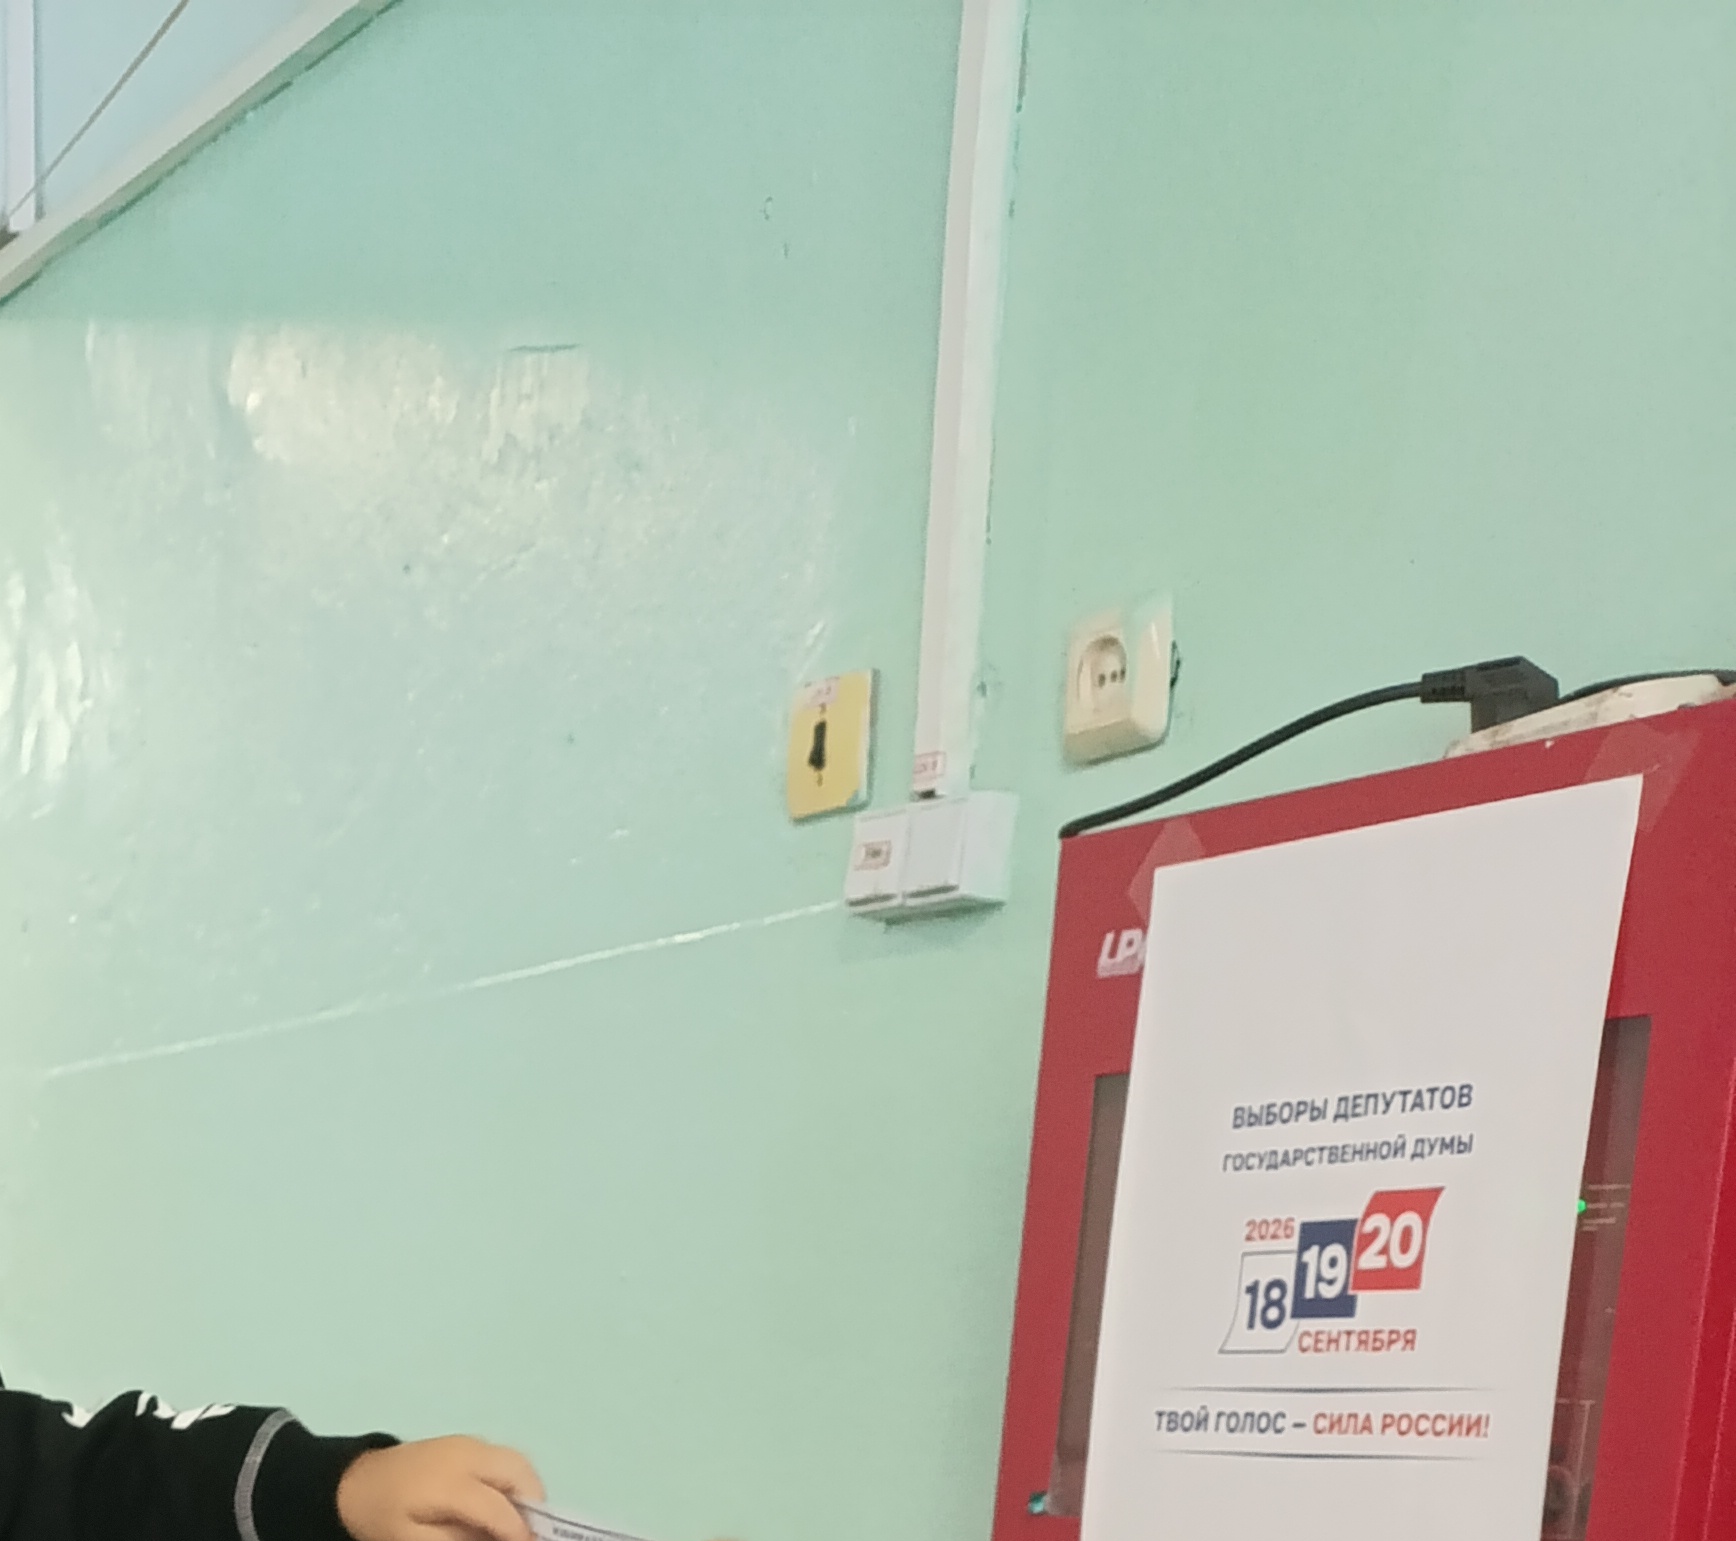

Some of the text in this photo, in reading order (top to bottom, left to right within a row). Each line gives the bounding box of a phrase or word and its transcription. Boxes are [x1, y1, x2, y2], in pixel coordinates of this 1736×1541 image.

[1232, 1083, 1473, 1129] ВЫБОРЫ ДЕПУТАТОВ
[1223, 1133, 1473, 1172] ГОСУДАРСТВЕННОЙ ДУМЫ
[1244, 1217, 1295, 1242] 2026
[1245, 1211, 1423, 1330] 18 19 20
[1298, 1329, 1417, 1353] СЕНТЯБРЯ
[1155, 1405, 1209, 1433] ТВОЙ
[1214, 1410, 1286, 1434] ГОЛОС
[1313, 1411, 1373, 1435] СИЛА
[1381, 1412, 1490, 1438] РОССИИ!
